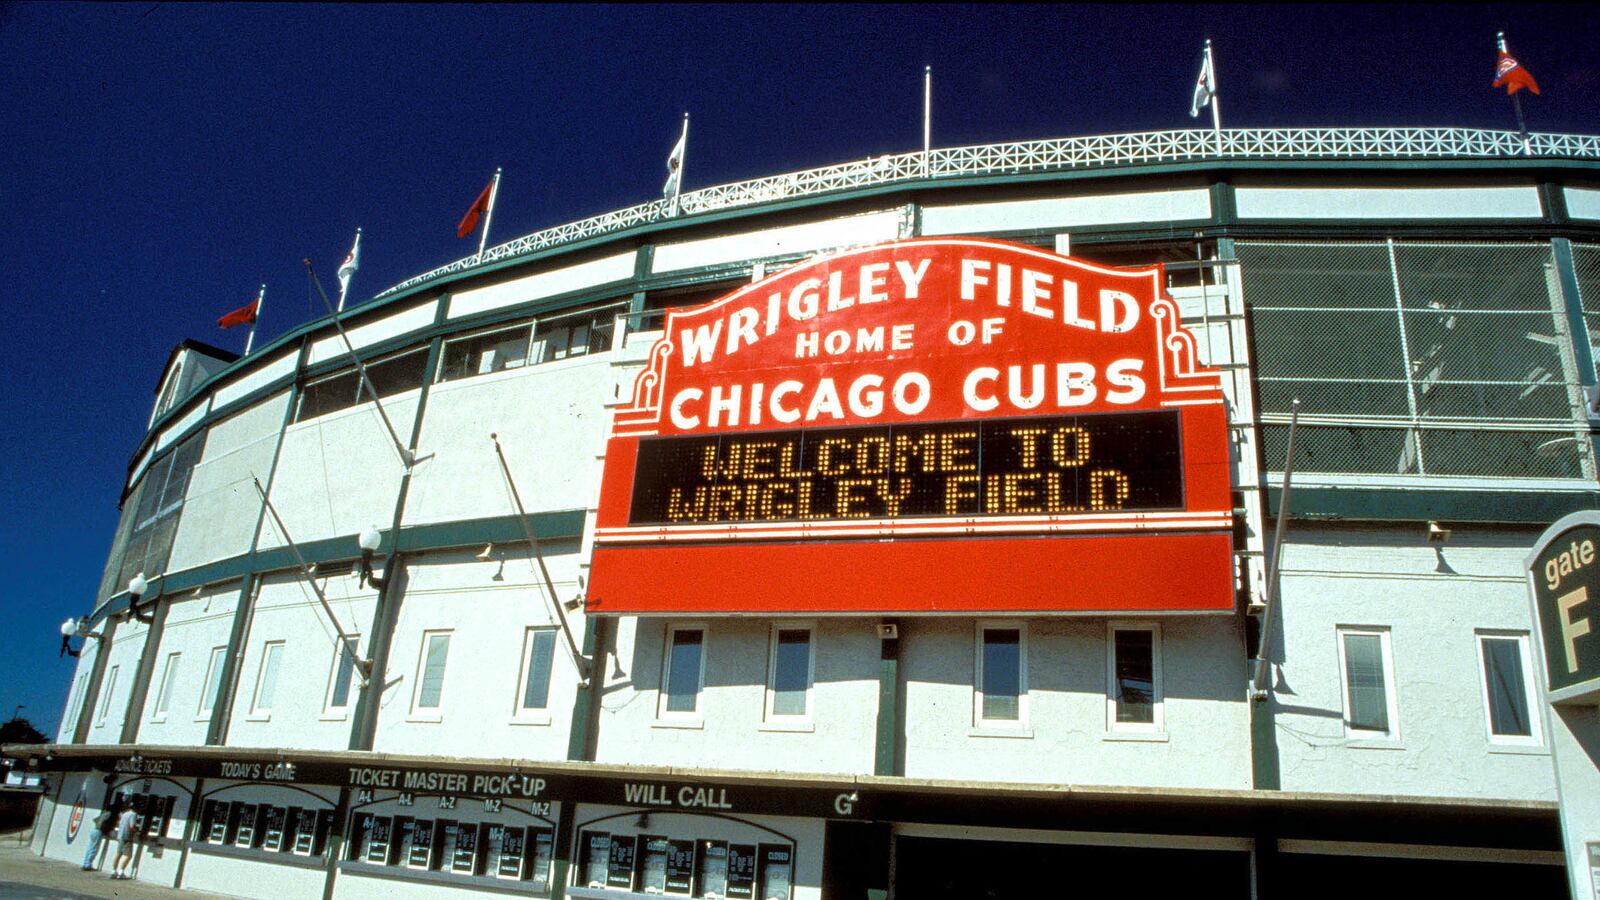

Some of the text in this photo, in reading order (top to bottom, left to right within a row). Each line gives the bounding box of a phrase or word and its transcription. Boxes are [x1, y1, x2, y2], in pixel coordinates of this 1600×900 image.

[680, 258, 1141, 368] WRIGLEY FIELD
[795, 317, 1008, 358] HOME OF
[669, 358, 1147, 430] CHICAGO CUBS
[703, 426, 1091, 481] WELCOME TO
[667, 469, 1131, 524] WRIGLEY FIELD
[1545, 539, 1595, 590] gate
[1556, 585, 1591, 674] F
[143, 759, 173, 775] TICKETS
[221, 761, 298, 781] TODAY'S GAME
[349, 768, 547, 797] TICKET MASTER PICK-UP
[359, 790, 372, 802] A-L
[399, 793, 413, 805] A-L
[440, 796, 456, 809] A-Z
[484, 799, 502, 813] M-Z
[531, 803, 550, 815] M-Z
[624, 783, 733, 809] WILL CALL
[833, 793, 853, 816] G
